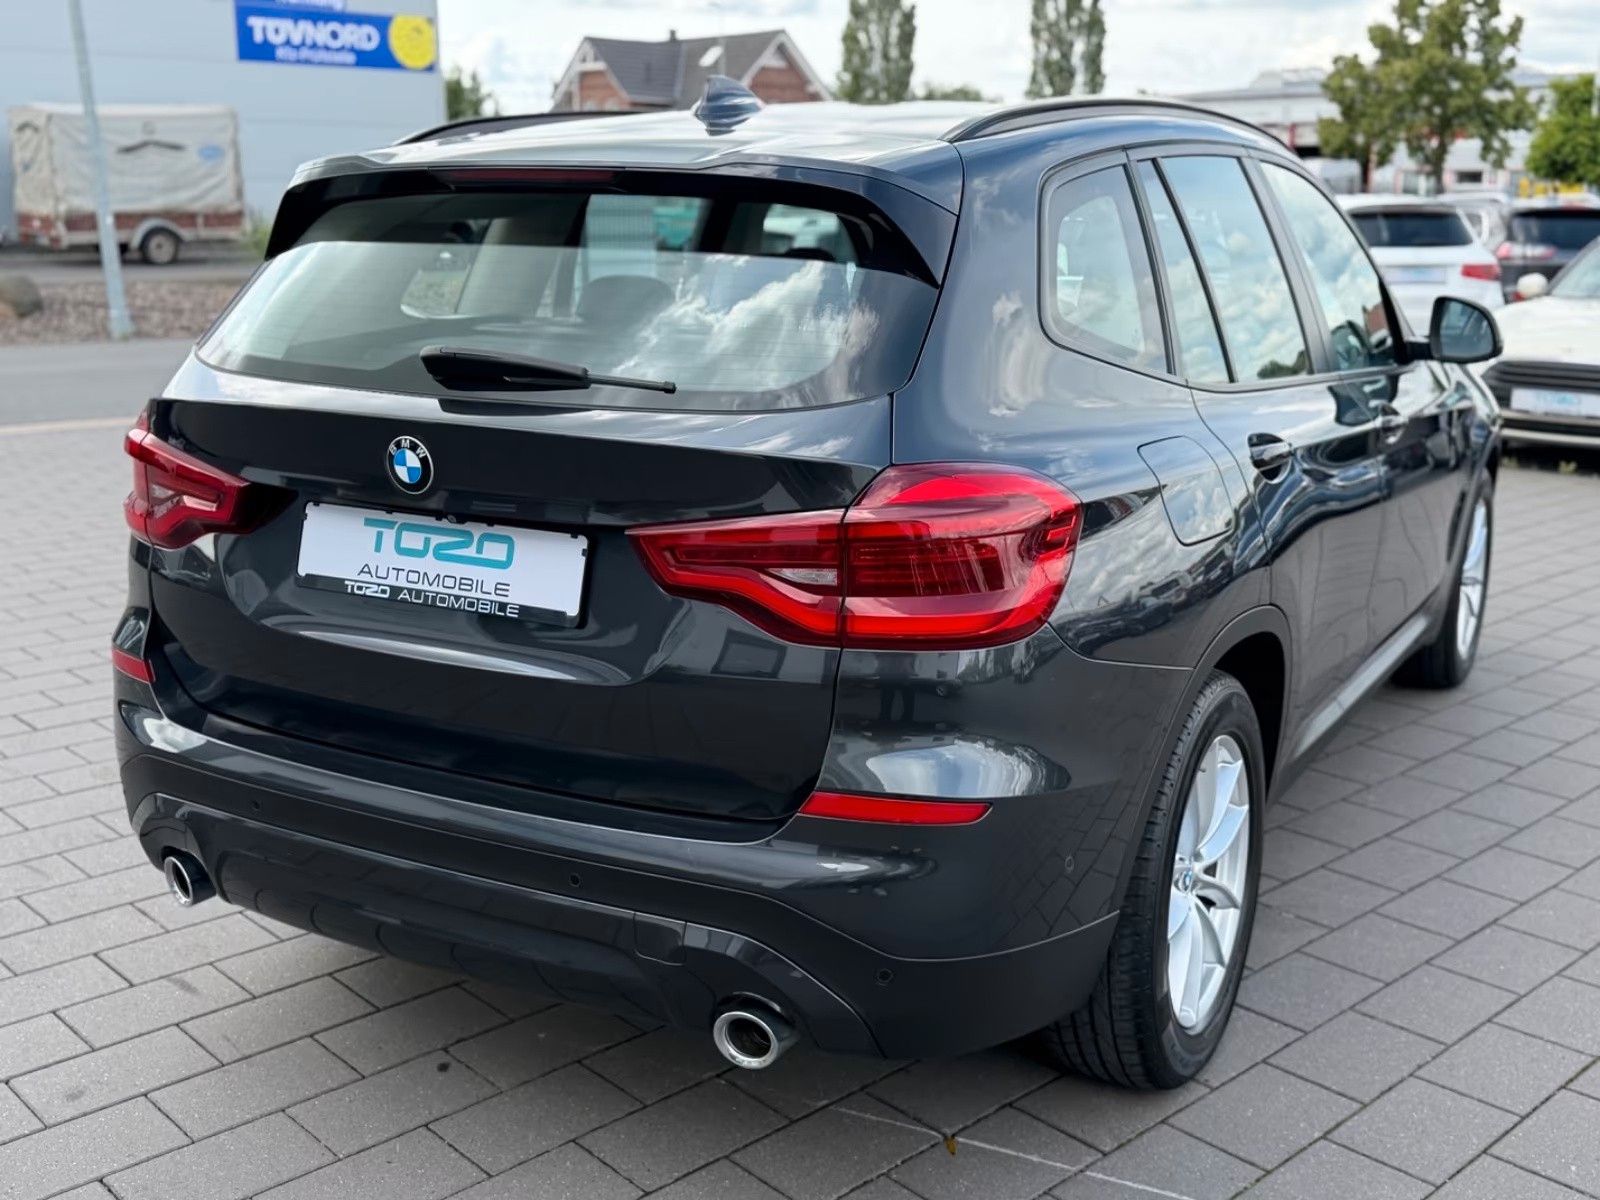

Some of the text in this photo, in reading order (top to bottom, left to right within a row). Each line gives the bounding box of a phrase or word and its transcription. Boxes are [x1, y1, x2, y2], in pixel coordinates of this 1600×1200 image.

[363, 516, 515, 570] TOZO
[344, 580, 520, 618] TOZO AUTOMOBILE
[357, 563, 511, 598] AUTOMOBILE
